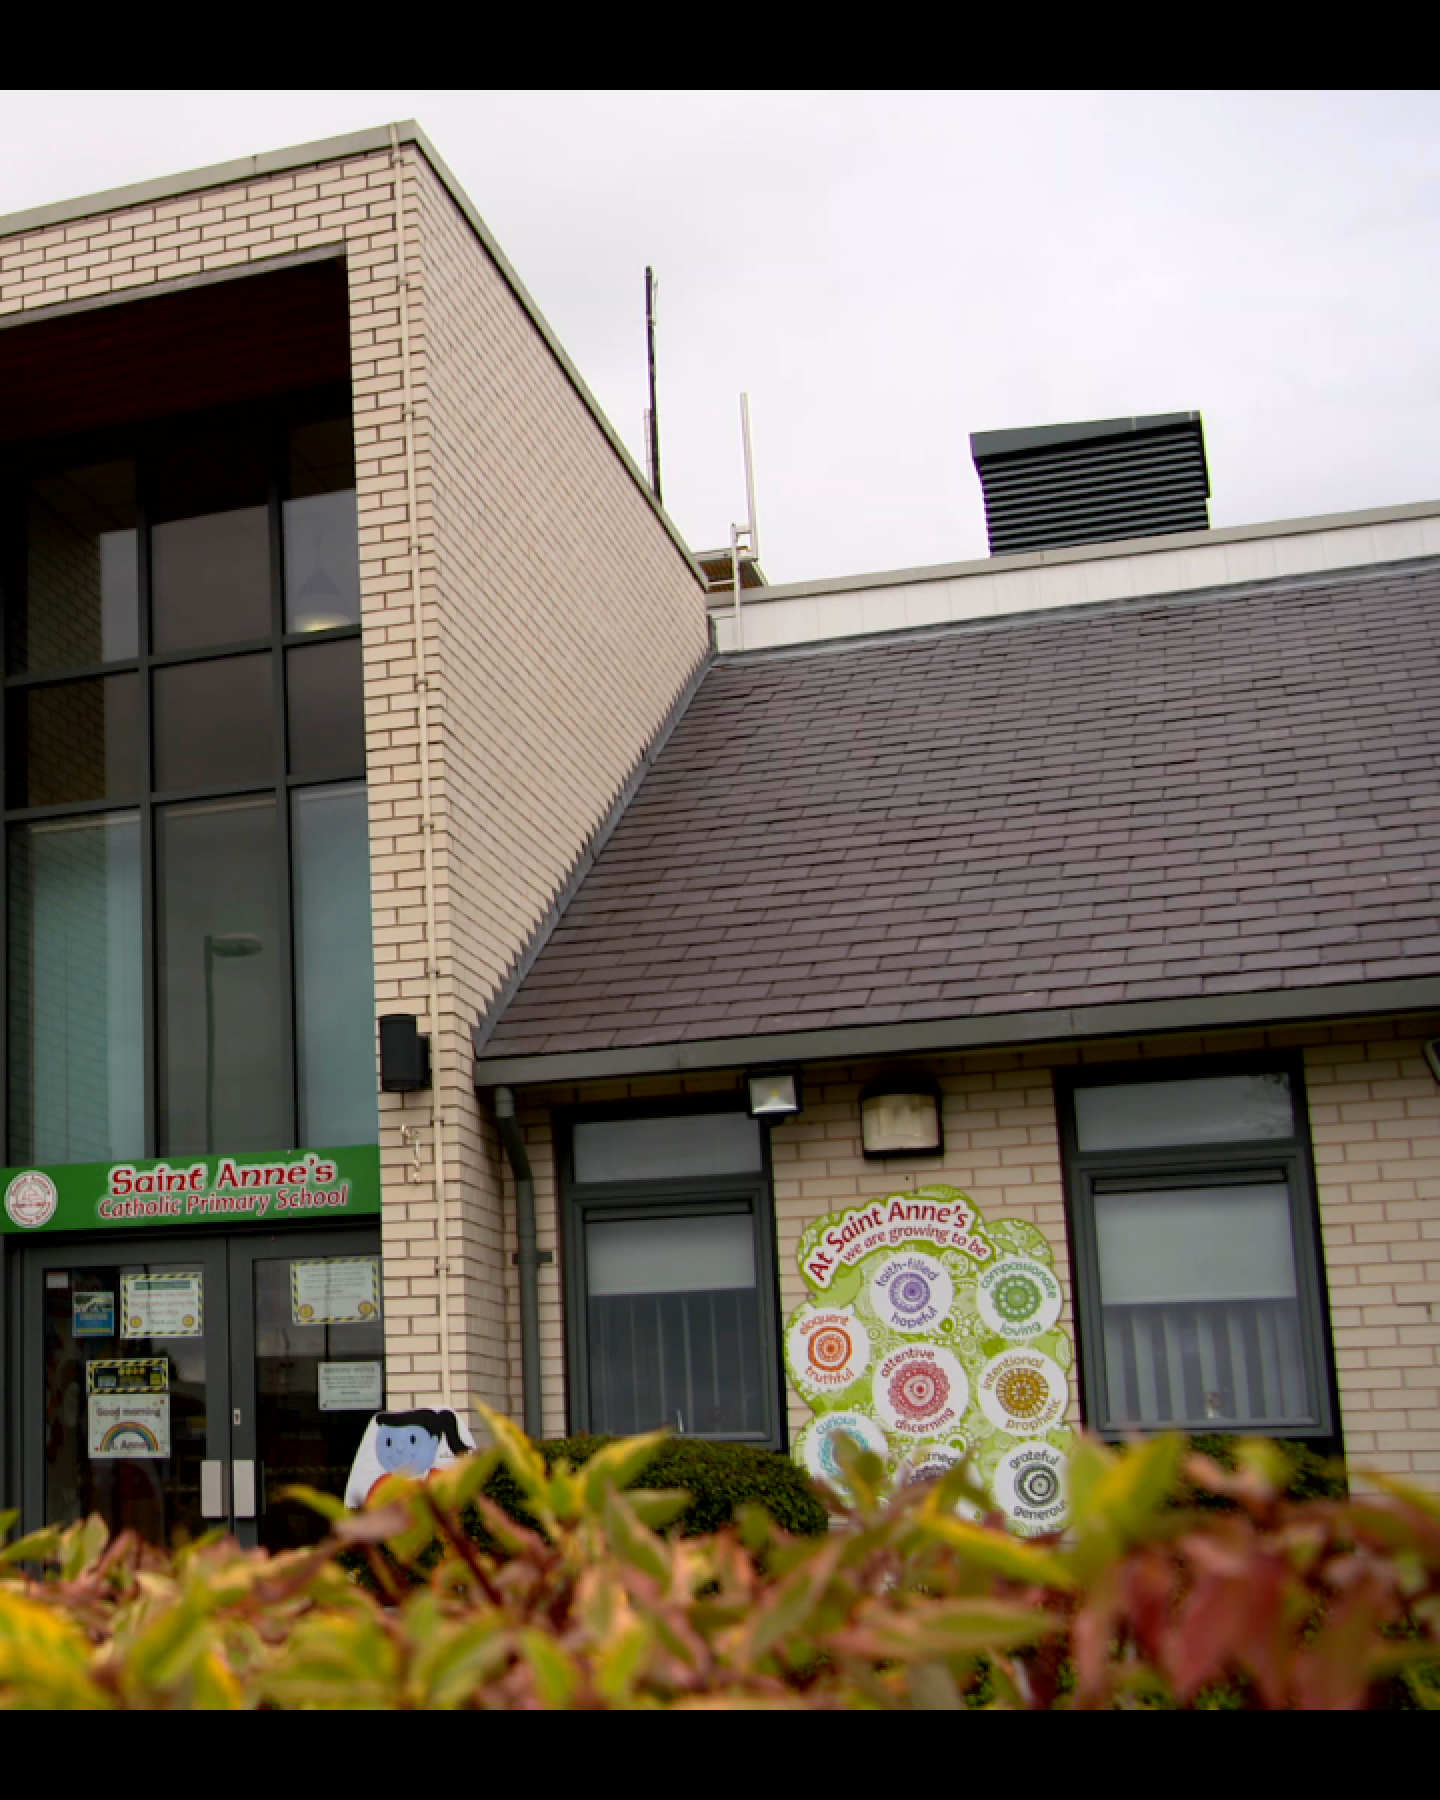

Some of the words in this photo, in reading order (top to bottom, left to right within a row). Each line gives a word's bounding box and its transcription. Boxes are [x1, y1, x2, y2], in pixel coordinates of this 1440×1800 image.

[111, 1166, 205, 1196] Saint
[216, 1156, 335, 1190] Anne's
[99, 1196, 182, 1219] Catholic
[186, 1192, 271, 1217] Primary
[275, 1183, 349, 1211] School
[808, 1251, 835, 1282] At
[825, 1206, 885, 1254] Saint
[887, 1200, 969, 1229] Anne's
[843, 1243, 864, 1262] we
[863, 1231, 887, 1249] are
[888, 1224, 951, 1245] growing
[951, 1231, 968, 1247] to
[967, 1236, 990, 1258] be
[874, 1257, 941, 1287] faith-filled
[981, 1261, 1057, 1299] compassionate
[799, 1313, 850, 1336] eloquent
[889, 1305, 939, 1330] hopeful
[999, 1321, 1043, 1338] loving
[804, 1365, 856, 1385] truthful
[880, 1347, 937, 1379] attentive
[982, 1355, 1045, 1391] intentional
[815, 1415, 857, 1435] curious
[894, 1407, 956, 1434] discerning
[1005, 1397, 1062, 1432] prophetic
[1009, 1449, 1061, 1471] grateful
